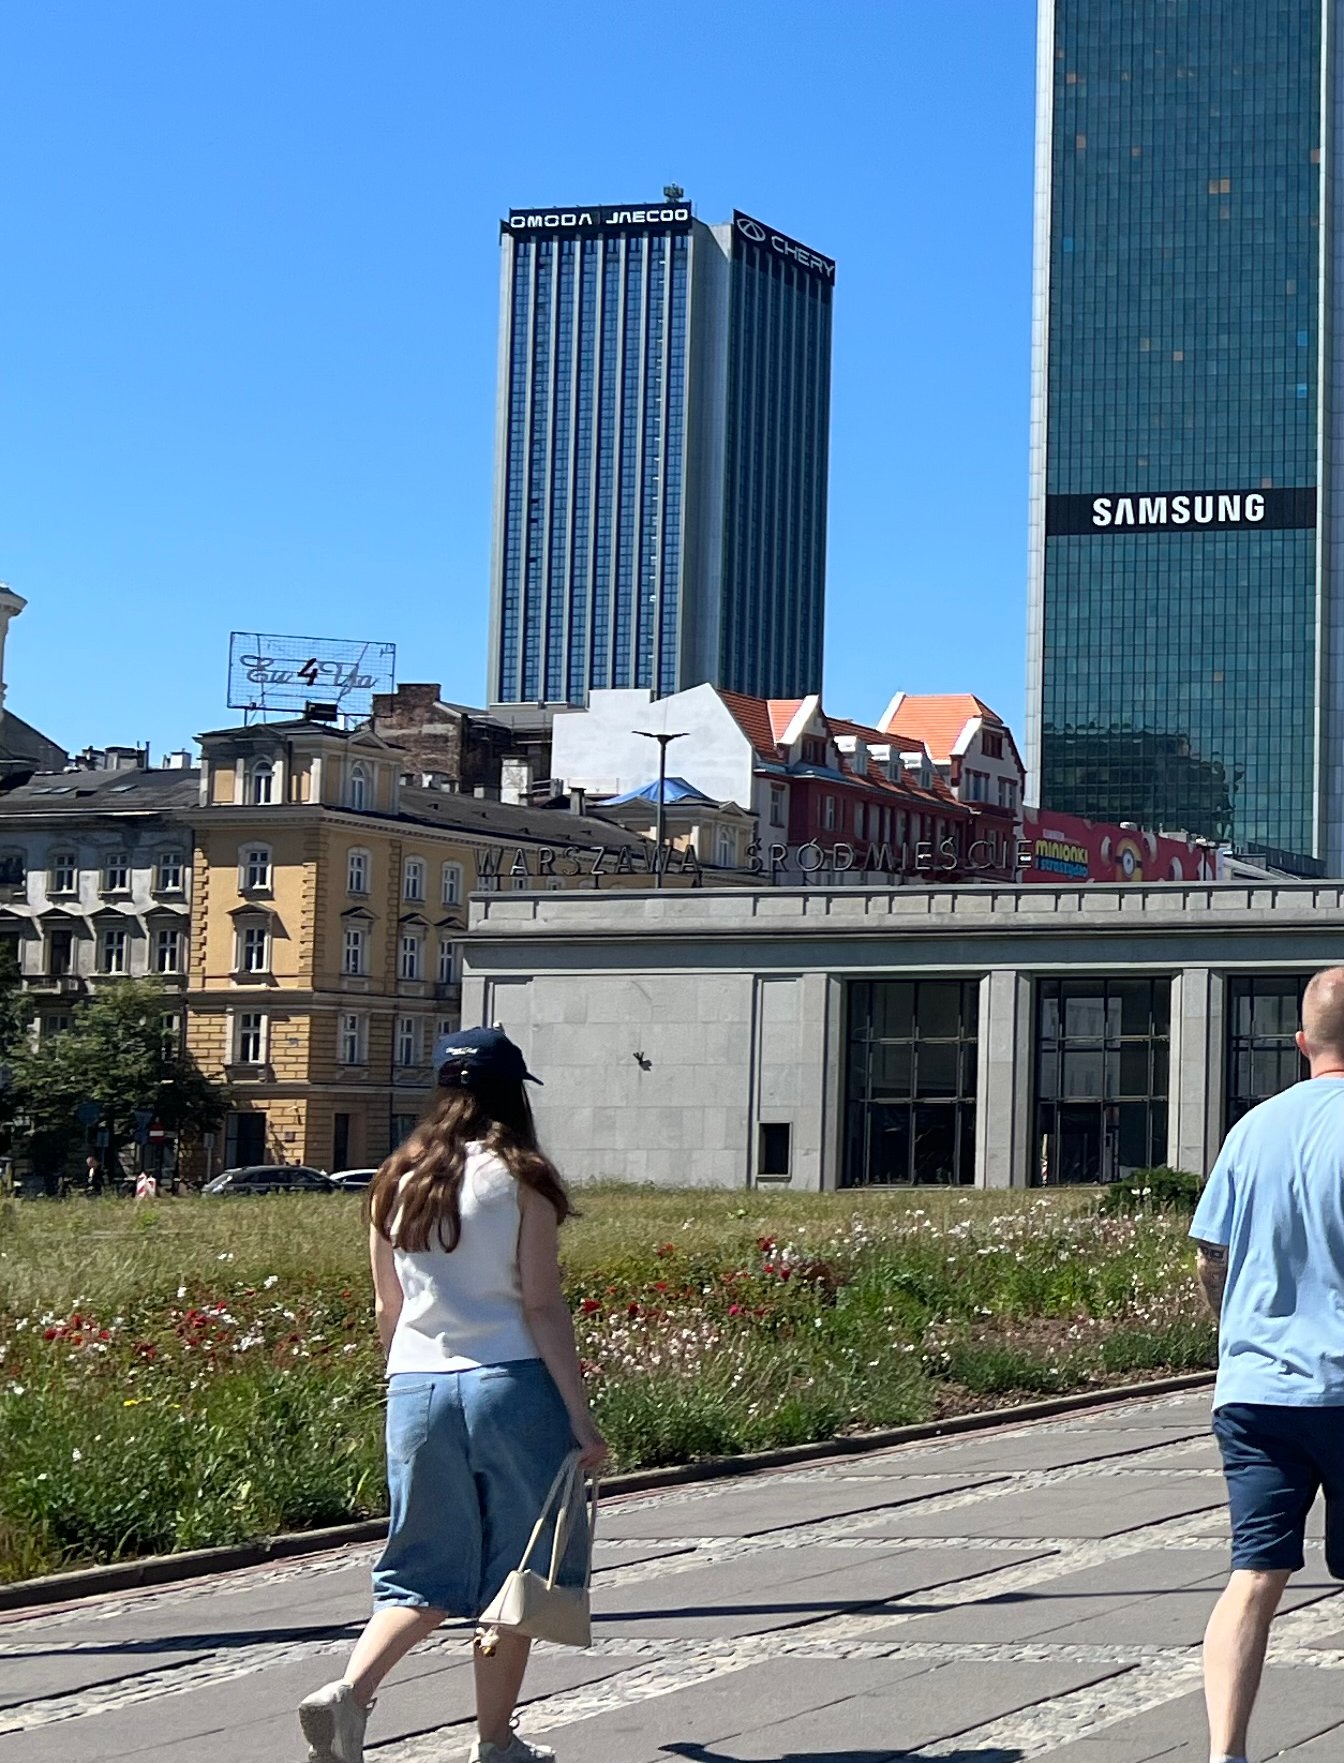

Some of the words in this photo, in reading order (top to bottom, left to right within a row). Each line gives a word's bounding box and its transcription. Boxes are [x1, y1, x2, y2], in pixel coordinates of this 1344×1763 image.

[510, 213, 593, 229] OMODA
[606, 208, 689, 225] JAECOO
[771, 236, 836, 276] CHERY
[1092, 494, 1266, 527] SAMSUNG
[475, 845, 703, 876] WARSZAWA
[745, 837, 1032, 872] ŚRÓDMIEŚCIE
